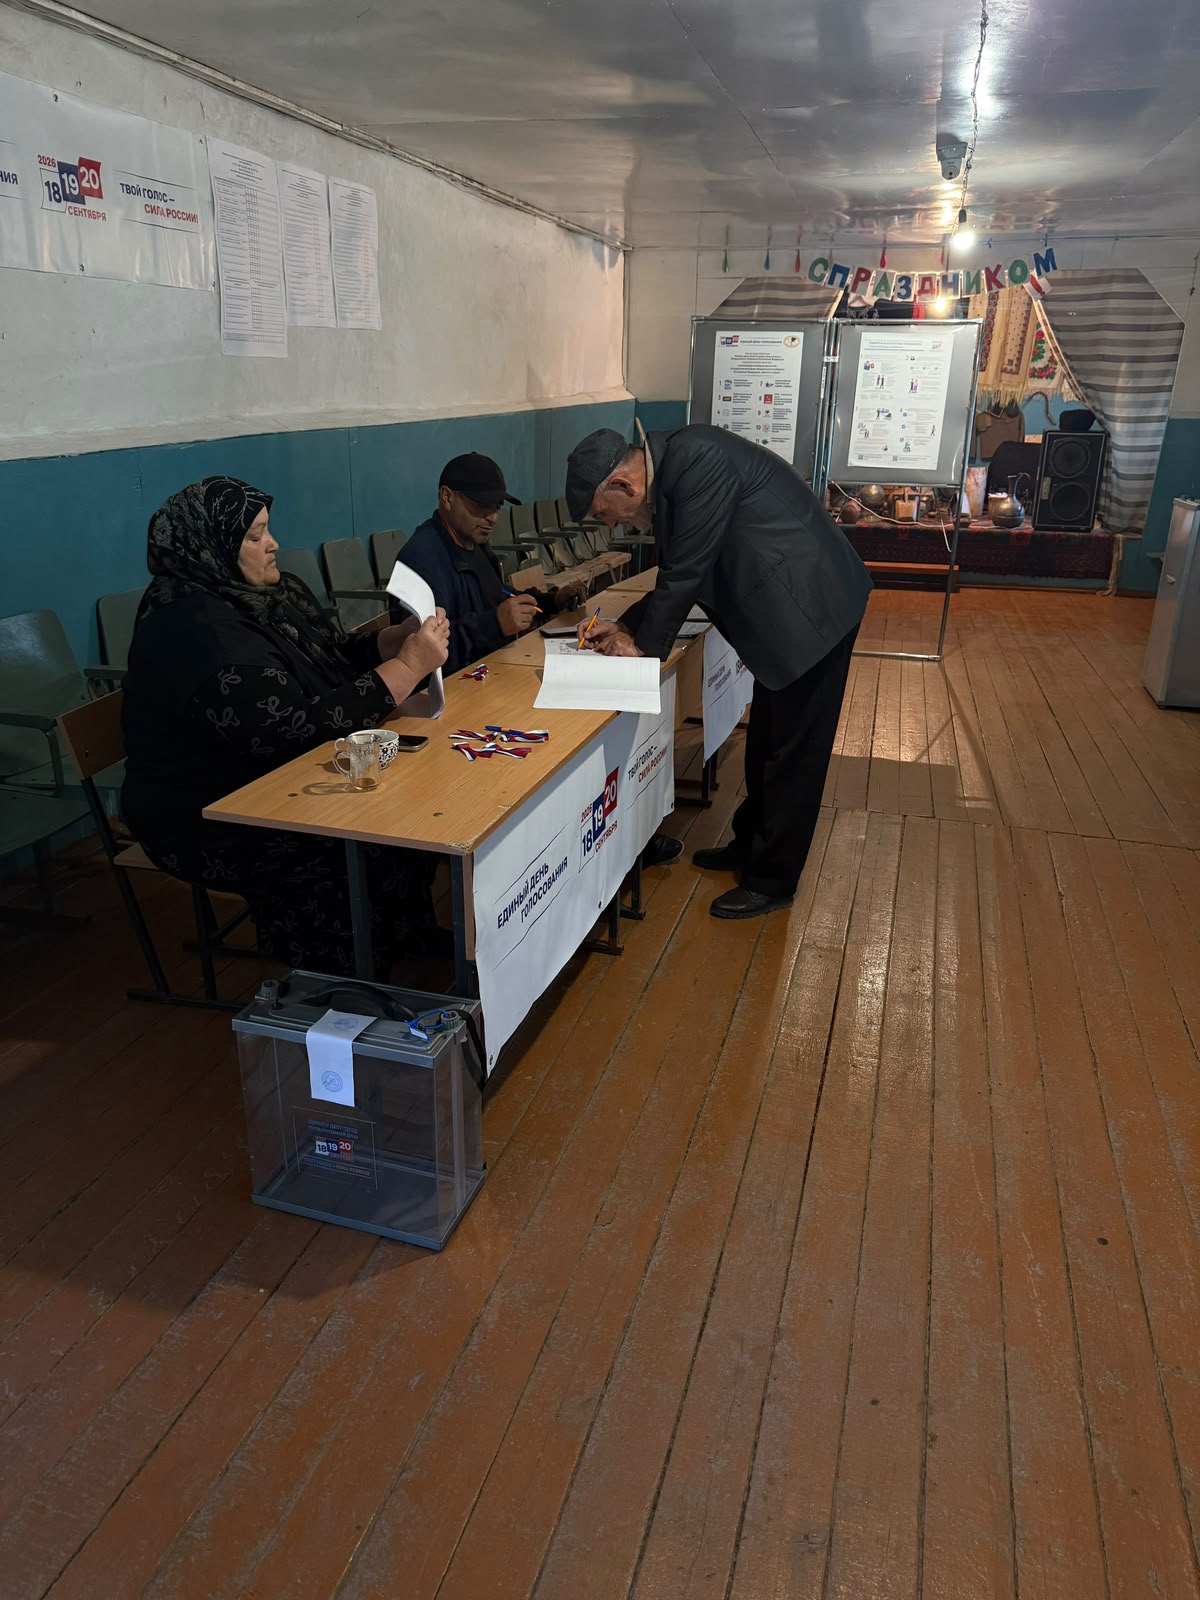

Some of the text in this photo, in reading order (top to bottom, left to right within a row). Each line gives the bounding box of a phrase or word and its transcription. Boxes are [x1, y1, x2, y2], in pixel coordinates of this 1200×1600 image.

[37, 154, 57, 168] 2026
[45, 166, 100, 203] 18 19 20
[119, 182, 142, 198] ТВОЙ
[142, 189, 168, 203] ГОЛОС
[67, 205, 107, 222] СЕНТЯБРЯ
[144, 203, 165, 218] СИЛА
[582, 781, 617, 857] 18 19 20
[497, 862, 549, 930] ЕДИНЫЙ ДЕНЬ
[521, 856, 568, 923] ГОЛОСОВАНИЯ
[316, 1141, 351, 1152] 18 19 20
